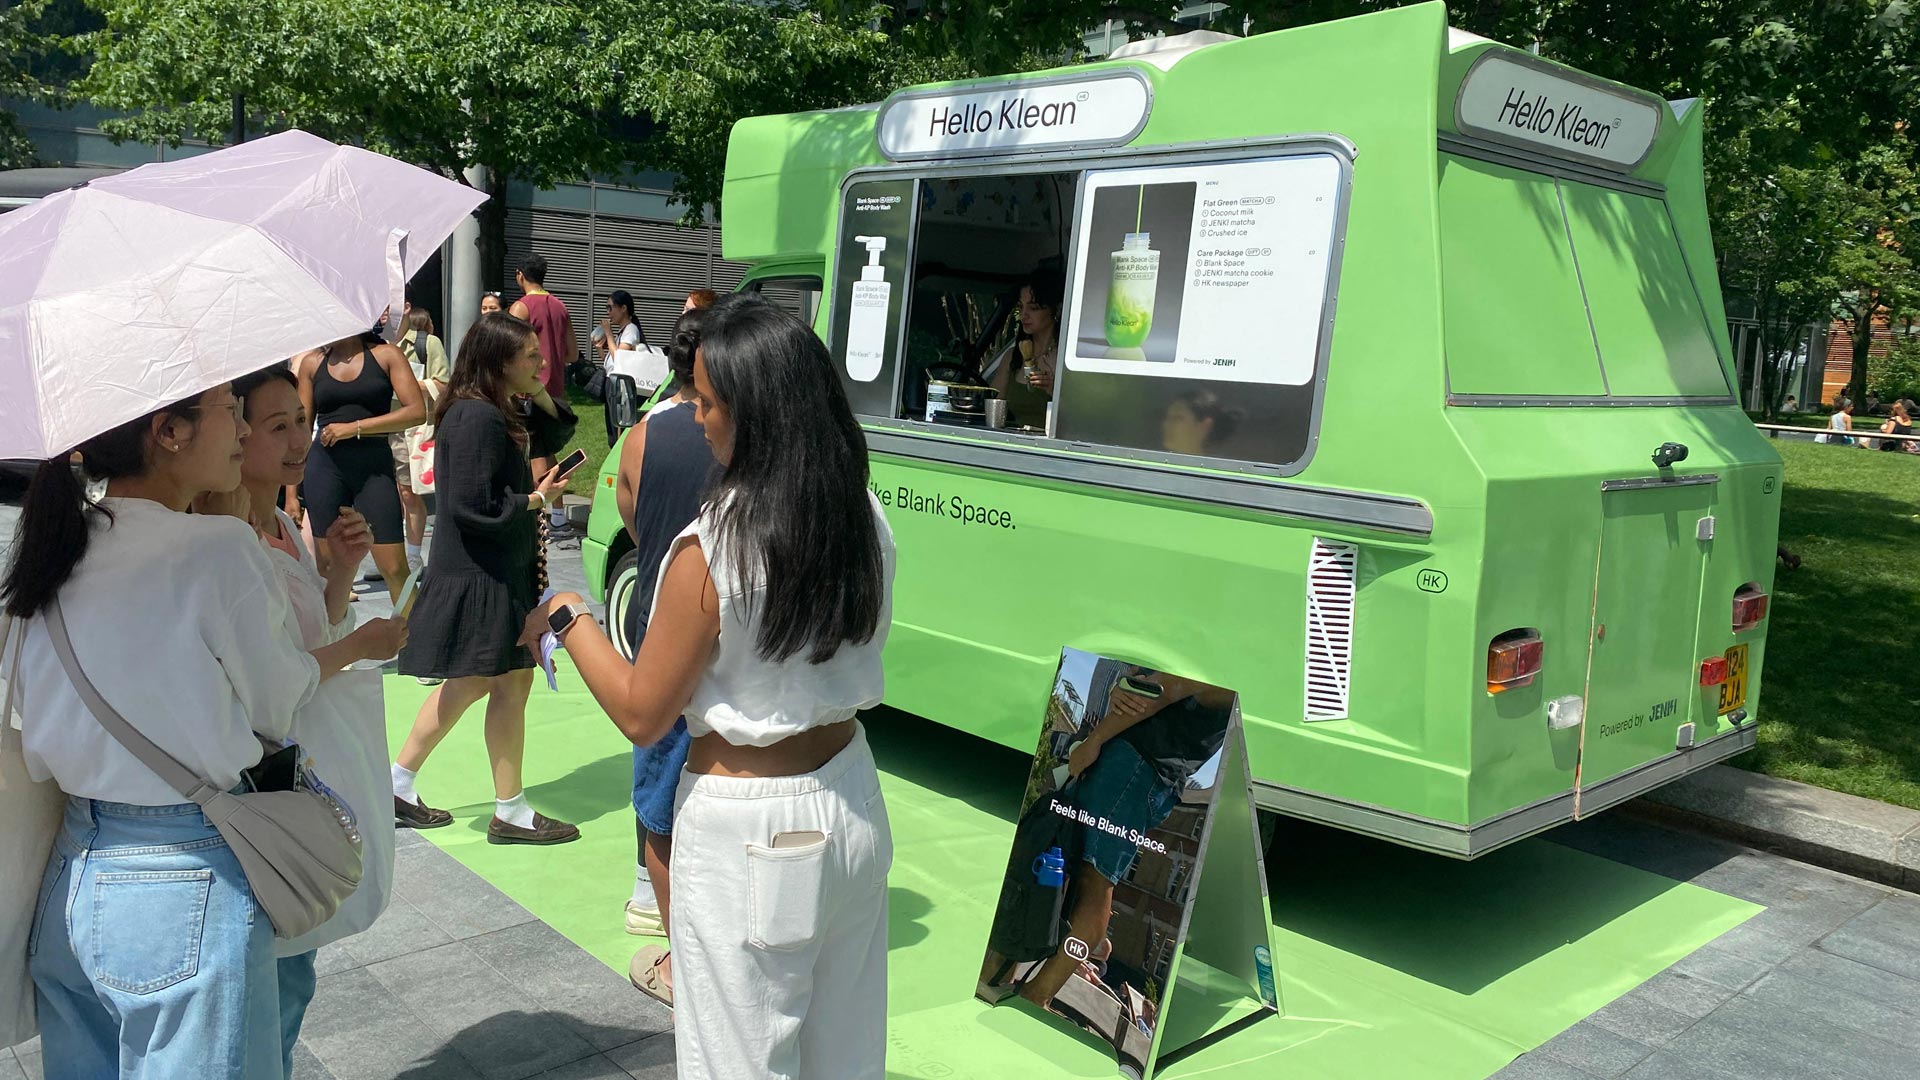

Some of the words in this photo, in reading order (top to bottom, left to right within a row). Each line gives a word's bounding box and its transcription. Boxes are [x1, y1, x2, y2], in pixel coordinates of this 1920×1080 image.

[929, 102, 992, 137] Hello
[998, 98, 1077, 131] Klean
[1498, 87, 1554, 134] Hello
[1553, 103, 1611, 149] Klean
[1203, 199, 1216, 207] Flat
[1217, 199, 1238, 207] Green
[1210, 209, 1239, 217] Coconut
[1230, 218, 1256, 226] matcha
[1207, 229, 1236, 237] Crushed
[1197, 249, 1213, 257] Care
[1214, 249, 1244, 258] Package
[1203, 259, 1222, 267] Blank
[1223, 259, 1245, 267] Space
[1224, 269, 1249, 277] matcha
[1250, 269, 1274, 277] cookie
[1212, 279, 1249, 288] newspaper
[635, 377, 645, 387] llo
[646, 379, 657, 388] Kle
[870, 482, 892, 506] ike
[897, 486, 946, 517] Blank
[949, 496, 1016, 530] Space.
[1726, 648, 1744, 678] 124
[1719, 680, 1741, 709] BJA
[1600, 714, 1634, 739] Powered
[1635, 713, 1645, 728] by
[1049, 798, 1077, 820] Feels
[1078, 809, 1096, 827] like
[1097, 816, 1128, 839] Blank
[1128, 828, 1167, 855] Space.
